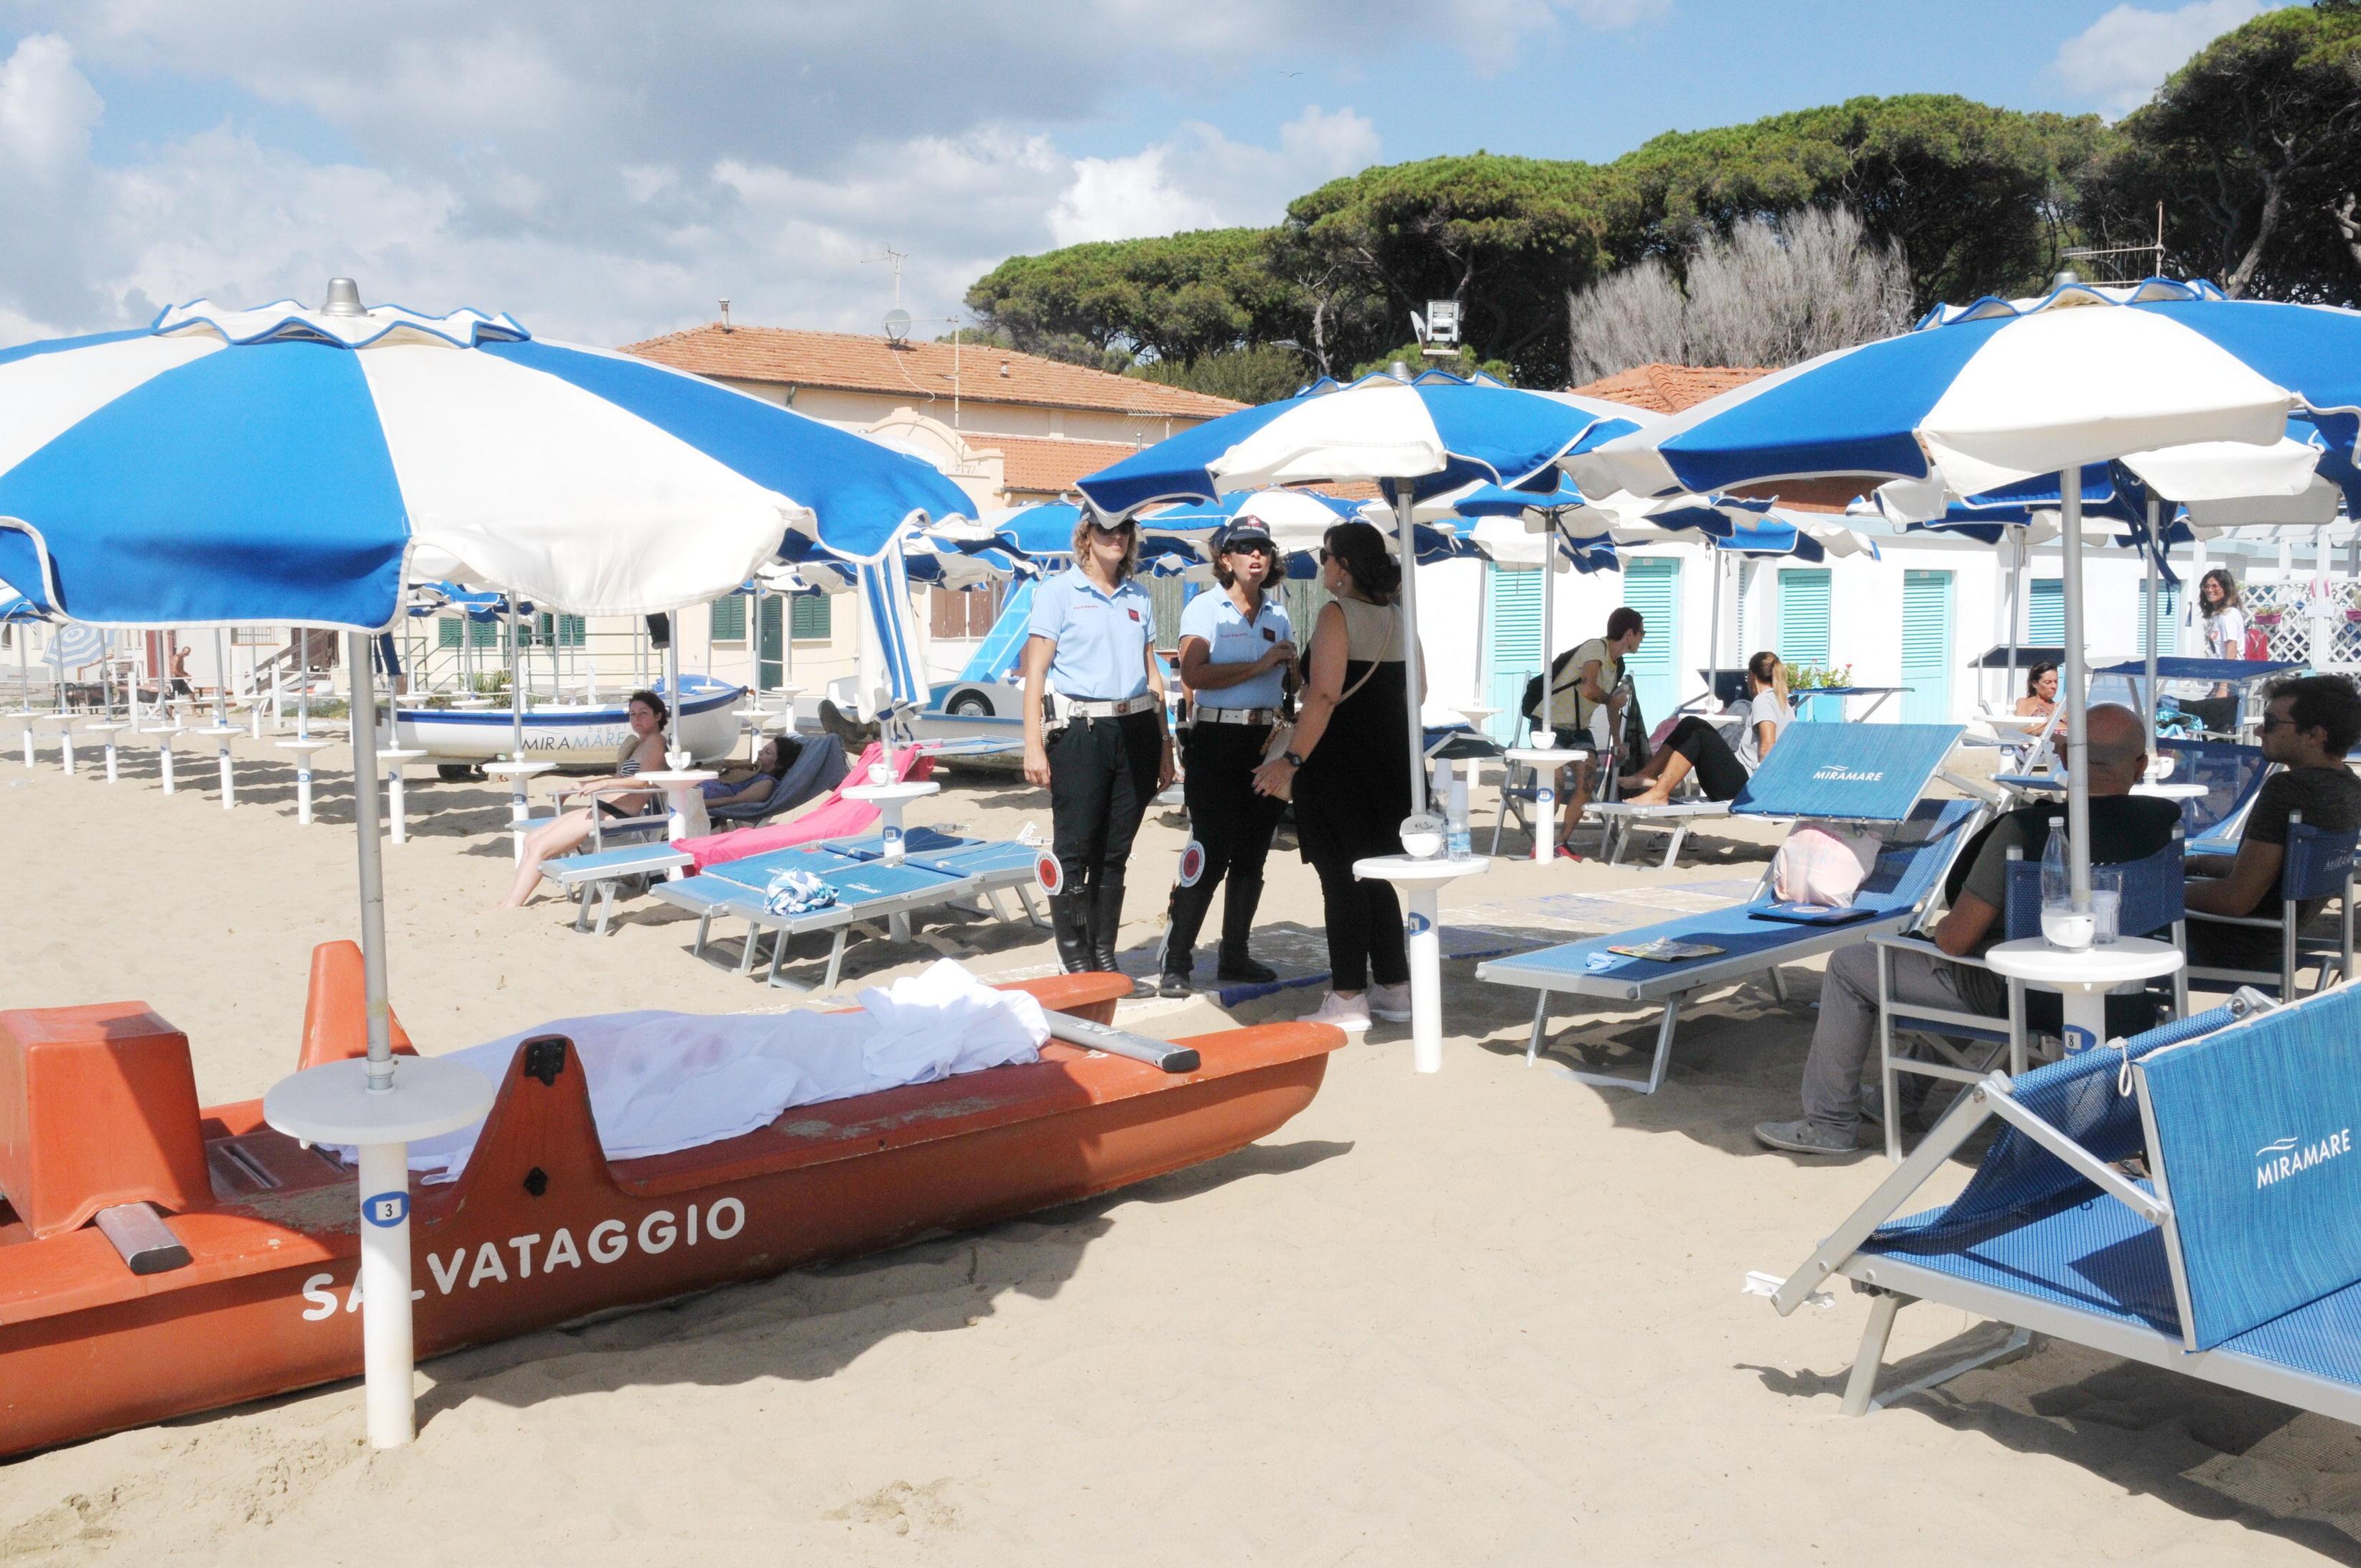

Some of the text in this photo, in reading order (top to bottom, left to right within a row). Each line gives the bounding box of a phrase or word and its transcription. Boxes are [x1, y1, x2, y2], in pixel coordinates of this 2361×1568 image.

[588, 725, 627, 734] bagni
[522, 732, 627, 751] MIRAMARE
[1812, 772, 1884, 782] MIRAMARE
[887, 831, 894, 839] 10
[2069, 1035, 2074, 1047] 8
[2257, 1128, 2351, 1190] MIRAMARE
[385, 1203, 393, 1218] 3
[302, 1197, 745, 1321] SVATAGGIO
